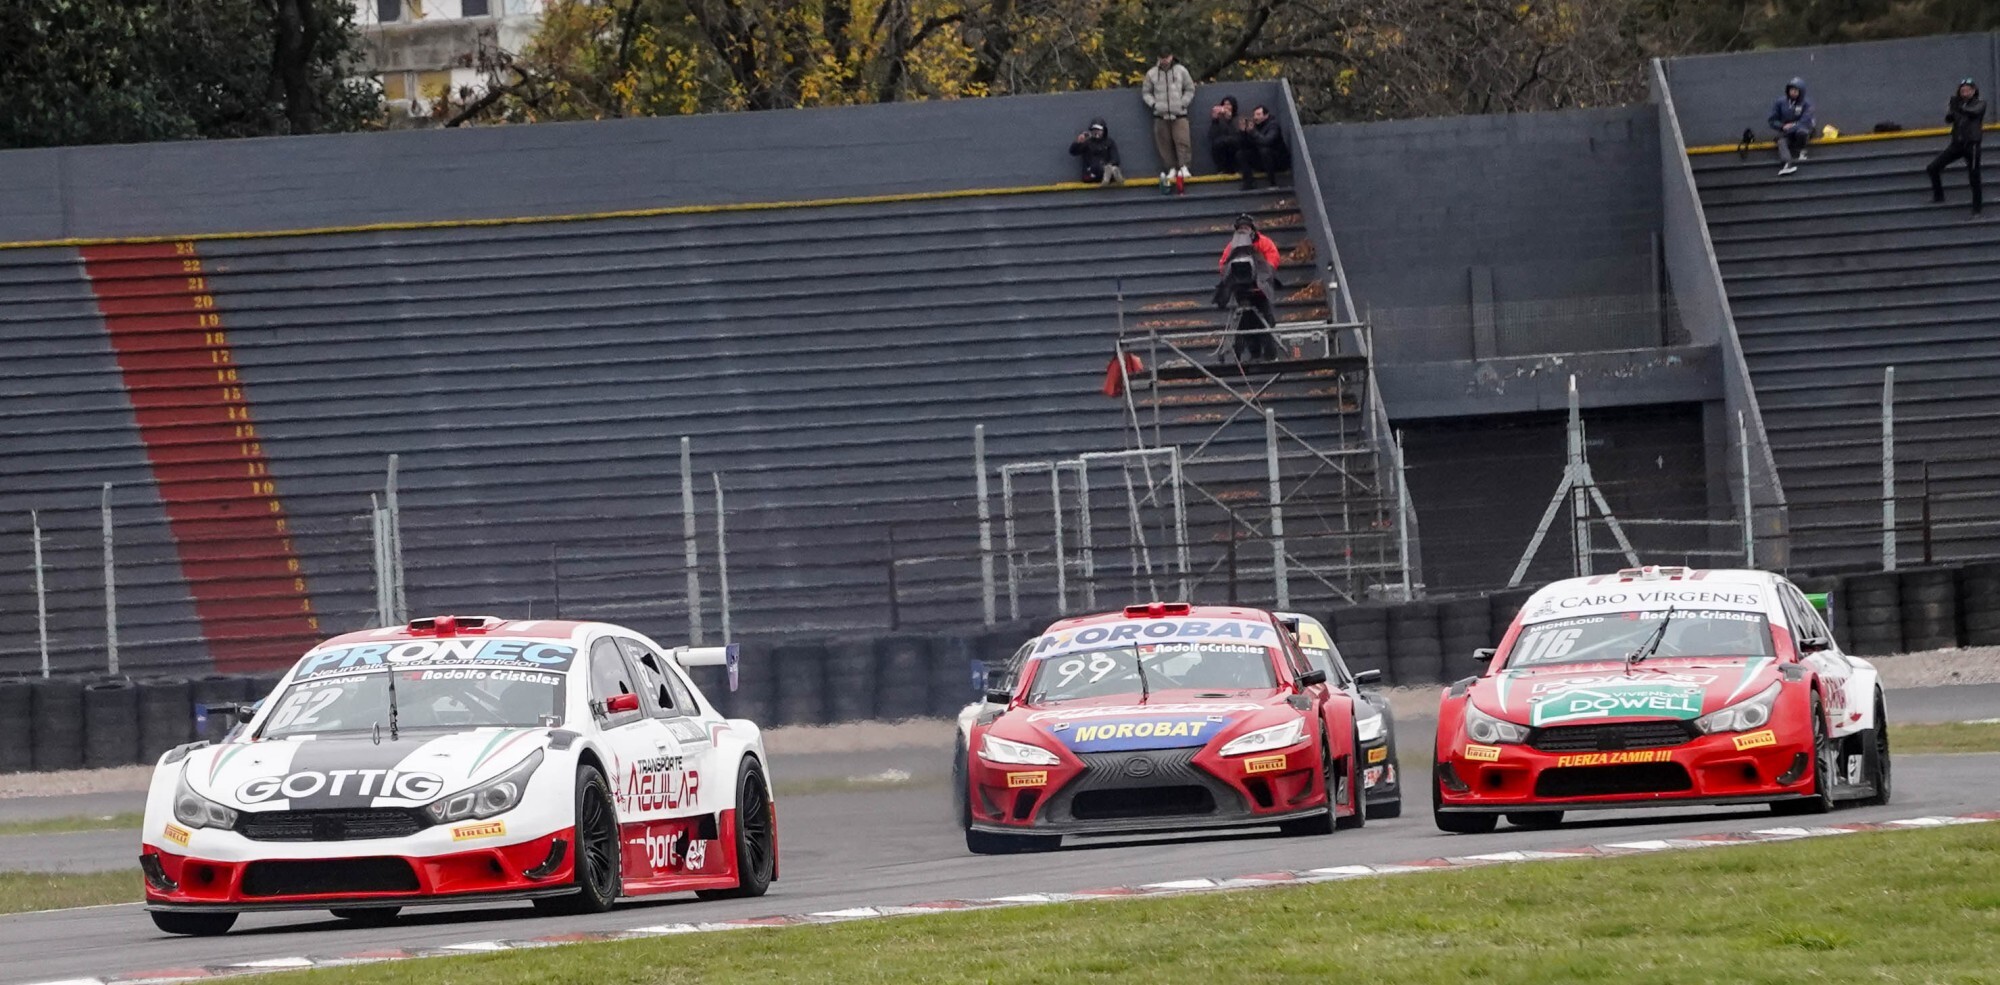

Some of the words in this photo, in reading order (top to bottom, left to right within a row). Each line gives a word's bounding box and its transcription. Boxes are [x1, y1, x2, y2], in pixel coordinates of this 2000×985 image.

[175, 242, 195, 254] 23
[183, 259, 201, 272] 22
[187, 277, 205, 290] 21
[194, 295, 214, 309] 20
[199, 313, 219, 327] 19
[205, 332, 225, 345] 18
[211, 350, 229, 364] 17
[217, 369, 237, 383] 16
[222, 387, 241, 400] 15
[228, 406, 248, 420] 14
[235, 425, 254, 438] 13
[241, 443, 260, 456] 12
[248, 462, 265, 475] 11
[252, 481, 274, 494] 10
[1560, 592, 1628, 609] CABO
[1637, 590, 1759, 606] VÍRGENES
[1700, 610, 1761, 623] Cristales
[1530, 616, 1605, 633] MICHELOUD
[1040, 621, 1275, 654] MOROBAT
[1513, 628, 1584, 667] 116
[298, 640, 575, 677] PRONEC
[410, 658, 433, 667] de
[422, 670, 487, 682] Rodolfo
[490, 670, 560, 686] Cristales
[1056, 657, 1117, 688] 99
[1612, 690, 1690, 699] VIVIENDAS
[267, 687, 344, 732] 62
[1569, 696, 1700, 713] DOWELL
[1074, 721, 1208, 743] MOROBAT
[1737, 732, 1773, 748] PIRELLI
[1467, 746, 1498, 760] PIRELLI
[1557, 753, 1607, 768] FUERZA
[1609, 750, 1655, 763] ZAMIR
[1655, 750, 1673, 762] !!!
[637, 755, 683, 775] TRANSPORTE
[1247, 756, 1286, 772] PIRELLI
[238, 769, 444, 802] GOTTIG
[1010, 773, 1048, 787] PIRELLI
[627, 761, 700, 814] AGUILAR
[164, 823, 190, 845] PIRELLI
[453, 822, 503, 838] PIRELLI
